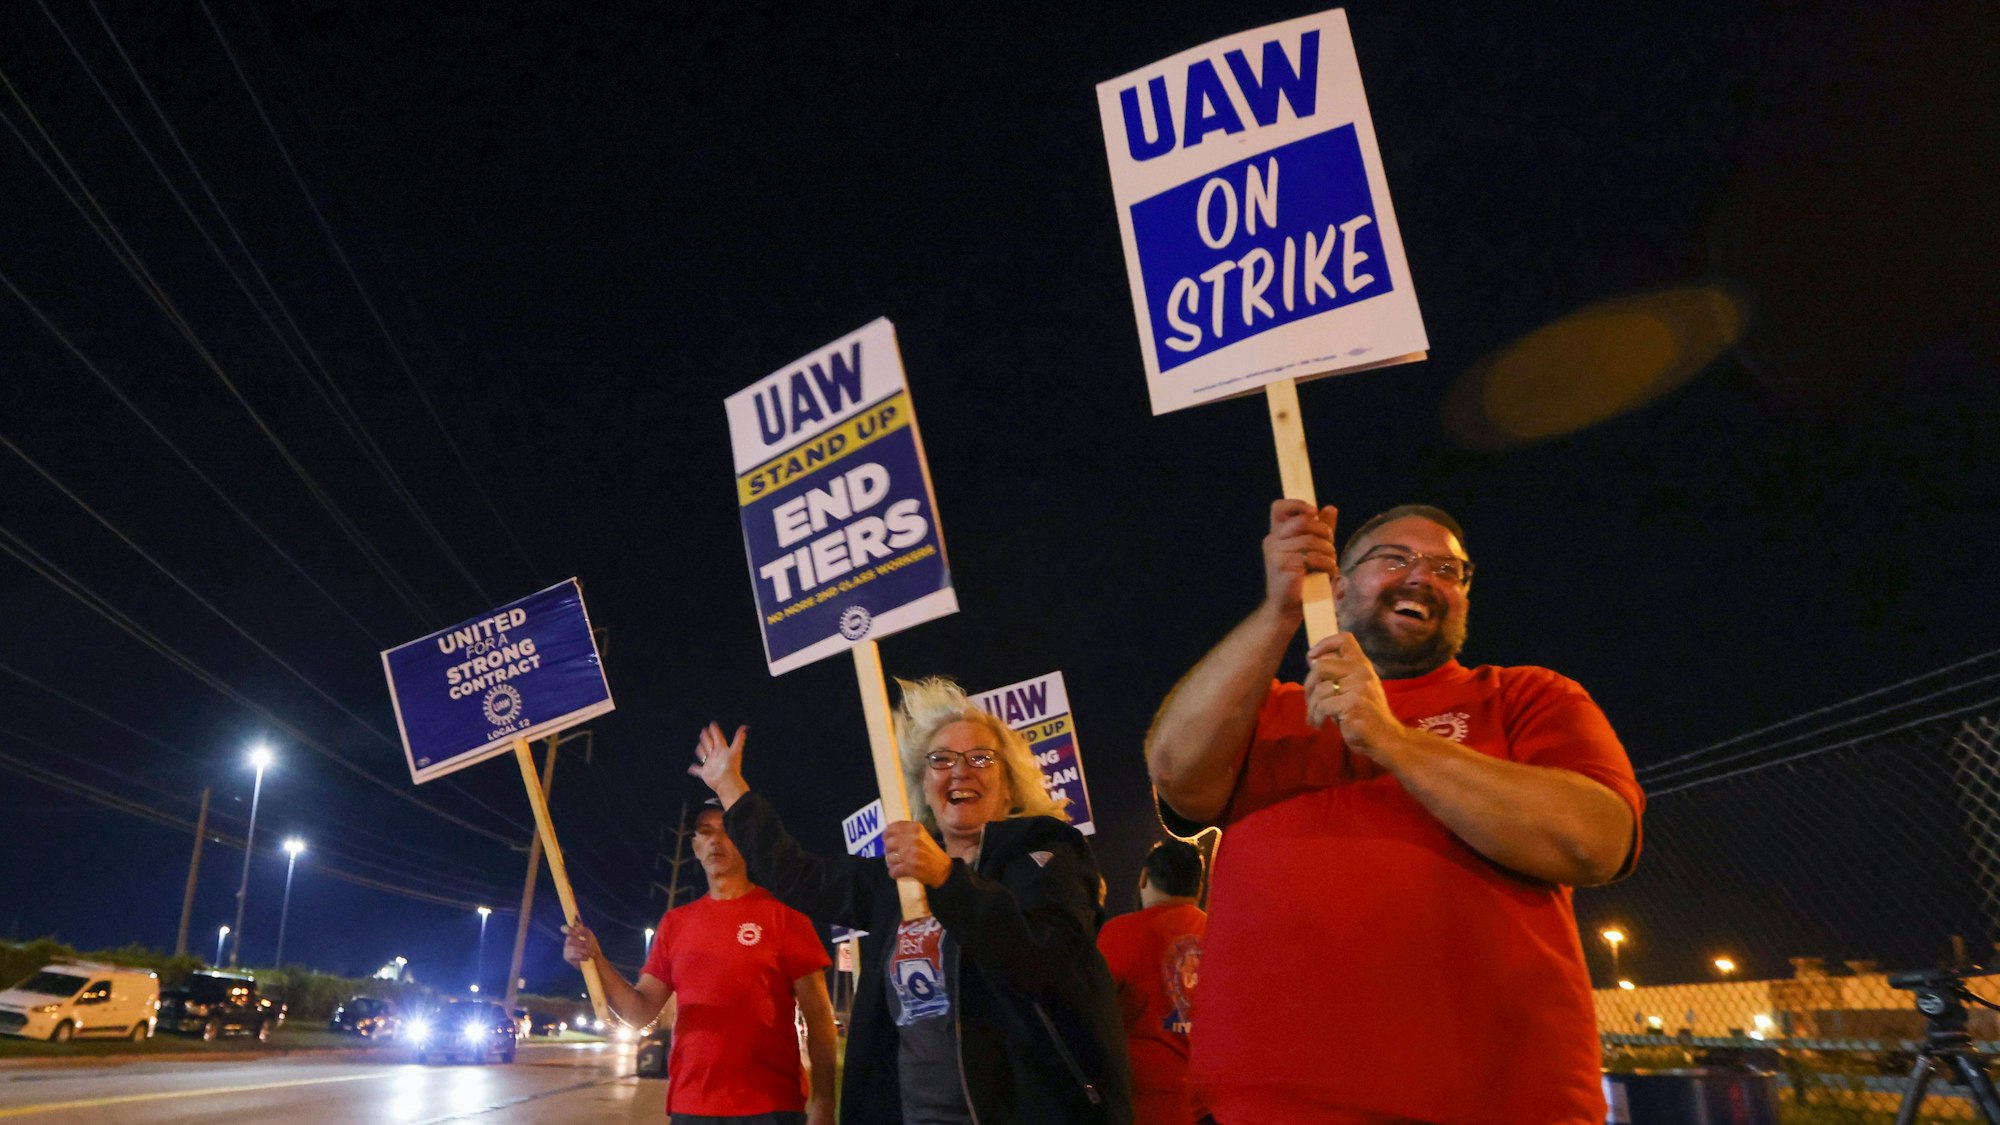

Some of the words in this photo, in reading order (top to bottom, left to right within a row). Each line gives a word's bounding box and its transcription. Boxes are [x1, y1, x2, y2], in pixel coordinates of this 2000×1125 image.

[1119, 29, 1320, 161] UAW
[1196, 156, 1279, 250] ON
[1164, 214, 1375, 352] STRIKE
[753, 342, 866, 446] UAW
[749, 432, 848, 496] STAND
[857, 405, 898, 441] UP
[772, 462, 891, 548] END
[760, 498, 929, 603] TIERS
[767, 611, 785, 625] NO
[784, 596, 816, 617] MORE
[815, 586, 839, 603] 2ND
[838, 569, 877, 592] CLASS
[876, 544, 936, 575] WORKERS
[437, 607, 527, 655] UNITED
[446, 638, 537, 685] STRONG
[465, 636, 496, 660] FOR
[498, 633, 509, 646] A
[449, 654, 540, 700] CONTRACT
[487, 724, 518, 740] LOCAL
[518, 718, 531, 728] 12
[1043, 720, 1065, 737] UP
[847, 805, 878, 844] UAW
